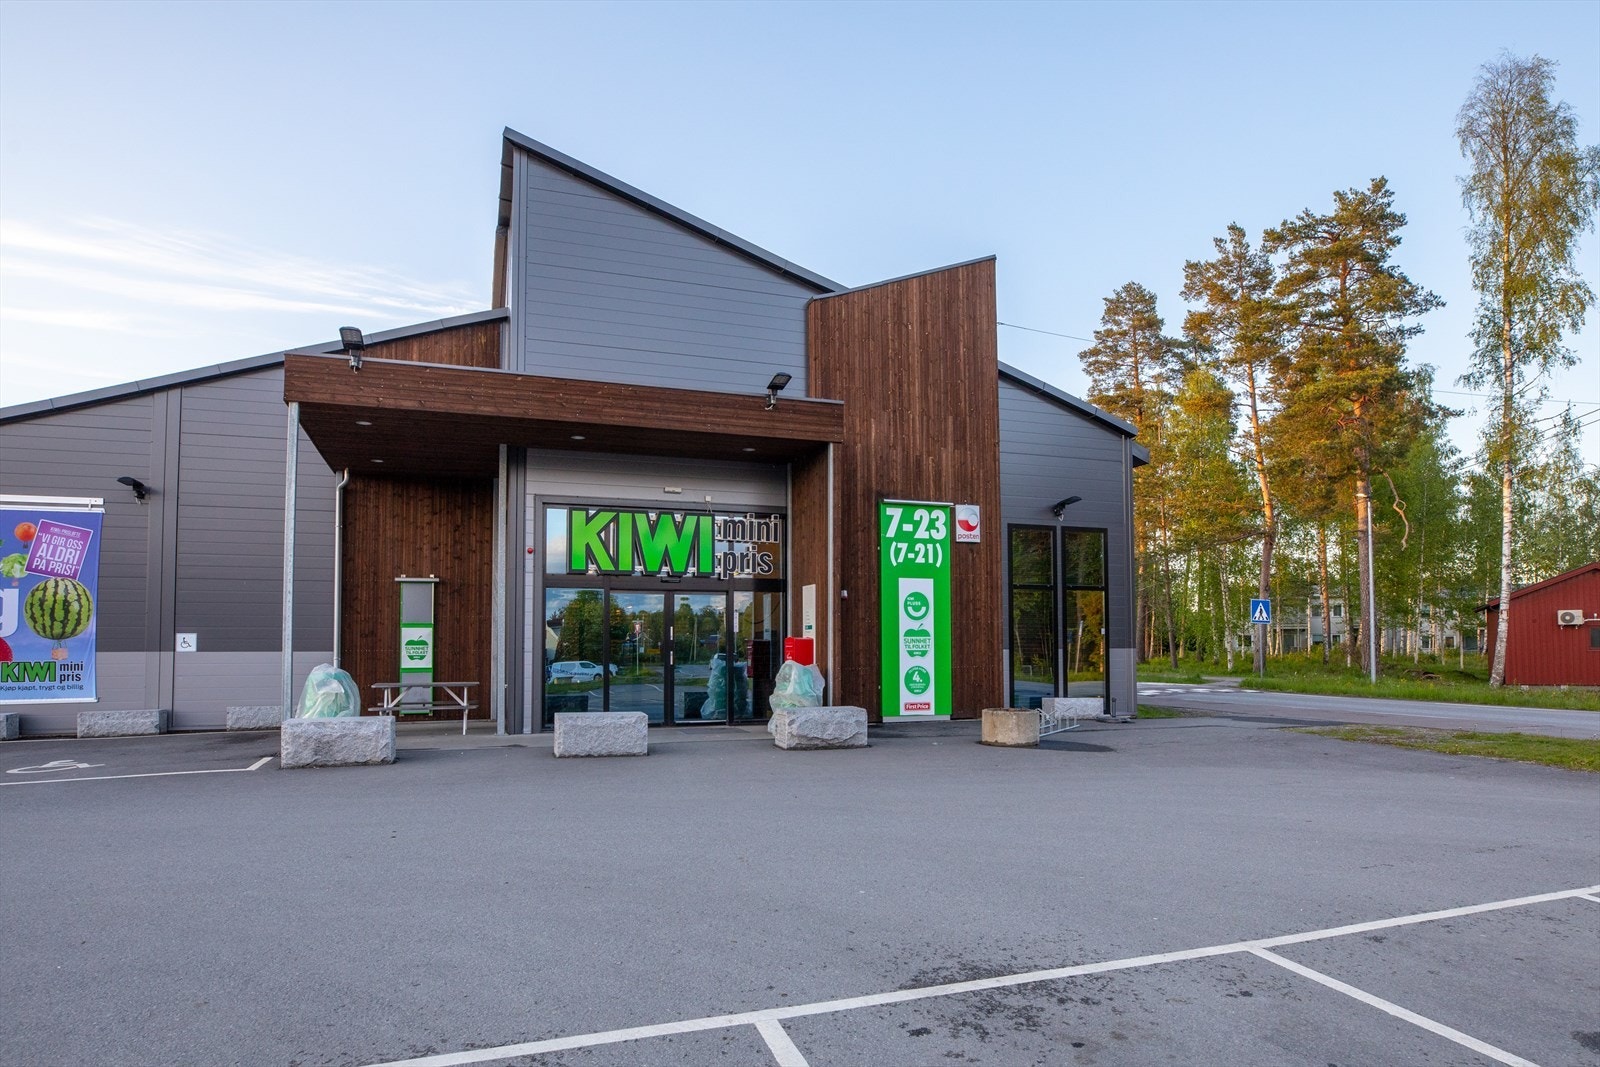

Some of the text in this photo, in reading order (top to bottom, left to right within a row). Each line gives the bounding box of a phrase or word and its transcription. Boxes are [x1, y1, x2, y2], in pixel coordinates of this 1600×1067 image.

[722, 513, 780, 543] mini
[885, 507, 947, 540] 7-23
[36, 542, 80, 565] ALDRI
[51, 535, 66, 546] GIR
[66, 538, 84, 550] OSS
[568, 507, 716, 577] KIWI
[720, 545, 774, 580] pris
[890, 541, 943, 568] (7-21)
[1, 661, 57, 682] KIWI
[60, 661, 84, 671] mini
[60, 671, 81, 684] pris
[39, 684, 55, 692] trygt
[67, 683, 84, 691] billig
